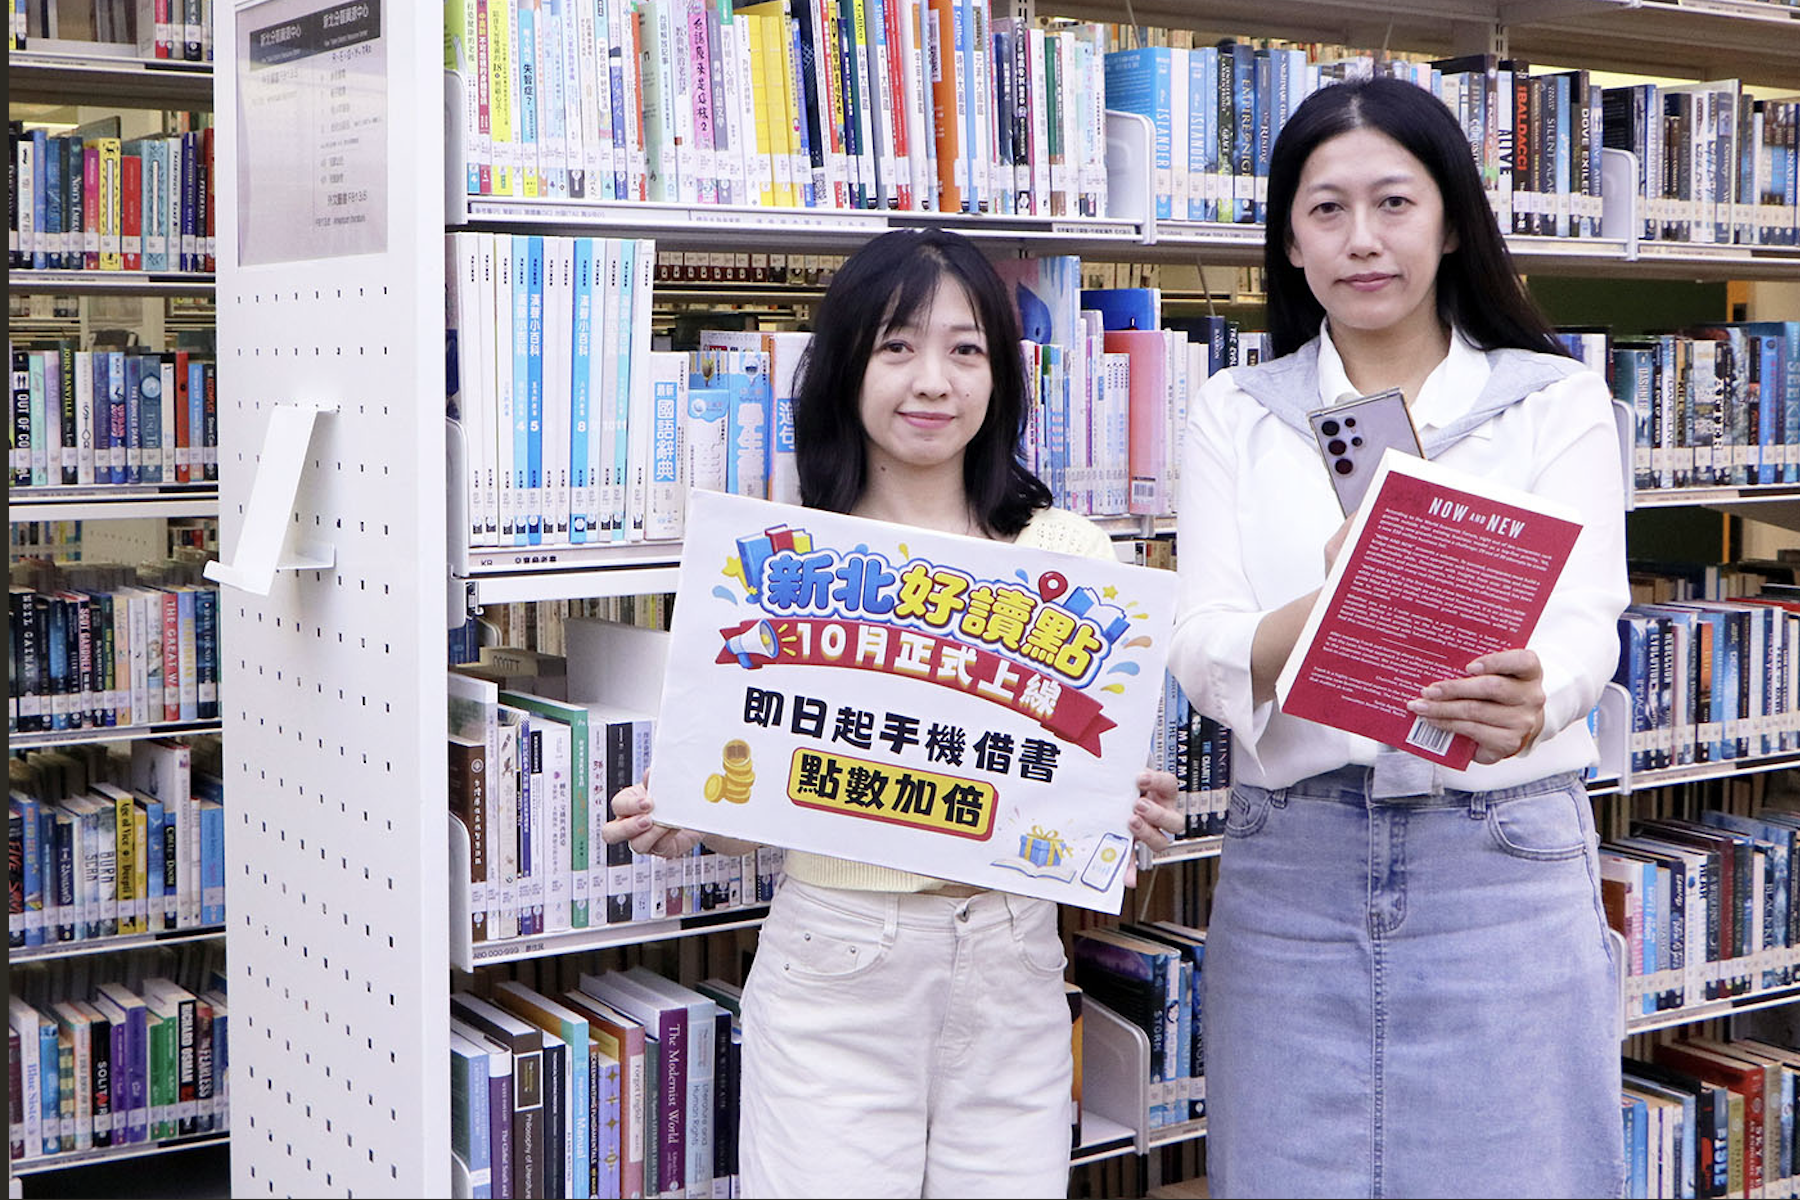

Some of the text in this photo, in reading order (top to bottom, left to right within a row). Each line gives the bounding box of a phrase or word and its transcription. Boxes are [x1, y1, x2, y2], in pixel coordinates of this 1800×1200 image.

[1241, 79, 1251, 130] EMPIRE
[1581, 108, 1590, 145] DOVE
[1157, 109, 1171, 169] ISLANDER
[1190, 112, 1204, 171] ISLANDER
[1259, 125, 1268, 163] Rising
[1499, 130, 1513, 176] ALIVE
[1517, 93, 1528, 171] BALDACCI
[1546, 118, 1556, 158] SILENT
[64, 348, 73, 418] JOHN BANVILLE
[1638, 367, 1649, 408] DASHNER
[1678, 381, 1686, 405] KILL
[1786, 360, 1799, 445] SEEKER
[17, 394, 30, 431] OUT OF
[530, 421, 540, 432] 5
[577, 421, 587, 432] 8
[1713, 376, 1725, 450] AFTER
[1428, 496, 1526, 540] NOW AND NEW
[23, 595, 38, 679] NEIL GAIMAN
[80, 608, 92, 674] SCOT GARDNER
[167, 601, 177, 667] THE GREAT
[765, 552, 1102, 681] 新北好讀點
[797, 621, 1062, 719] 10月正式上線
[1650, 634, 1659, 684] EVOLUTION
[743, 686, 1062, 784] 即日起手機借書
[1168, 720, 1176, 739] THE
[1177, 731, 1188, 788] MAPMA
[1201, 741, 1212, 783] THE CHARITY
[796, 754, 986, 829] 點數加倍
[121, 829, 132, 846] Vice
[100, 851, 114, 884] BURN
[181, 1003, 194, 1083] RICHARD OSMAN
[1153, 1010, 1163, 1051] STORM
[27, 1063, 38, 1090] Blue
[633, 1064, 642, 1090] Forget
[667, 1024, 680, 1144] The Modernist World
[577, 1118, 586, 1158] Manual
[691, 1085, 700, 1146] Human Rights
[701, 1084, 709, 1146] Literature and
[525, 1114, 533, 1199] Philosophy of Literature
[1755, 1126, 1763, 1157] SKY
